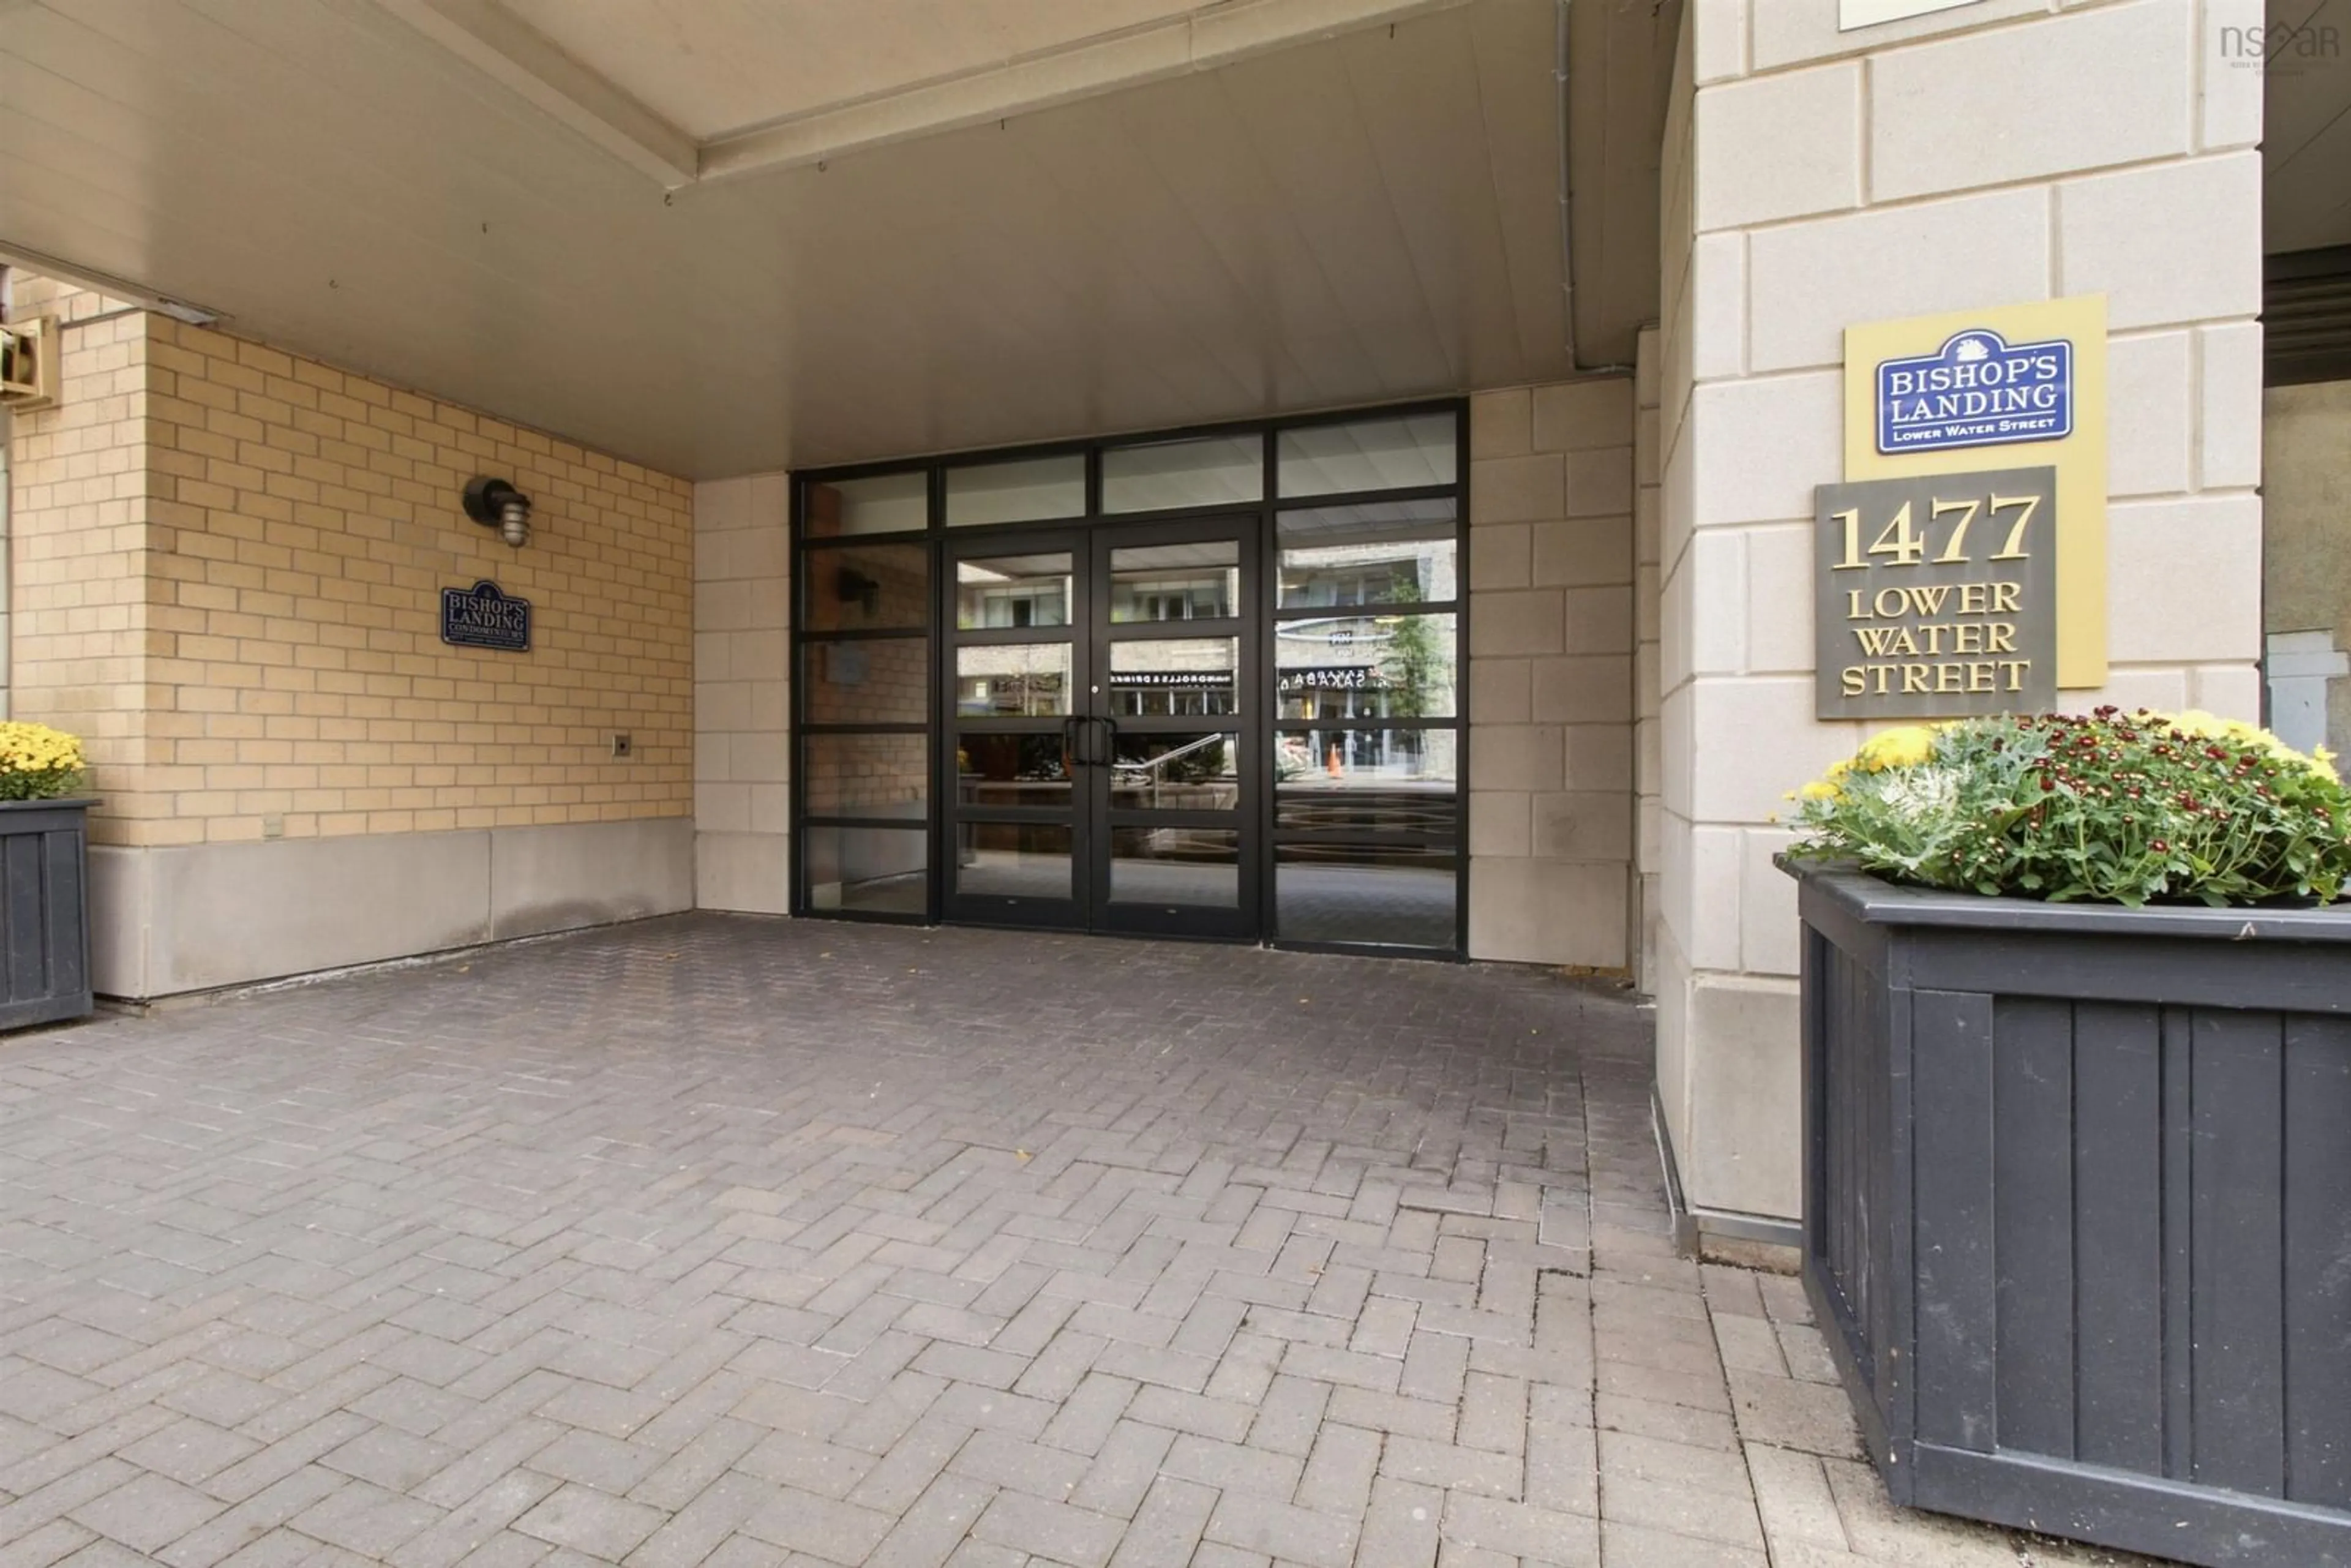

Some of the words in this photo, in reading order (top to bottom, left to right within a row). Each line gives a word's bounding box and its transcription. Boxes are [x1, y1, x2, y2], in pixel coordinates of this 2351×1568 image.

[1890, 355, 2058, 396] BISHOP'S
[1891, 384, 2058, 423] LANDING
[1892, 429, 1942, 442] LOWER
[1945, 424, 1995, 437] WATER
[1998, 418, 2057, 432] STREET
[1831, 492, 2042, 571] 1477
[449, 594, 525, 615] BISHOP'S
[1847, 581, 2023, 620] LOWER
[449, 609, 524, 631] LANDING
[1851, 621, 2018, 658] WATER
[1841, 659, 2031, 697] STREET
